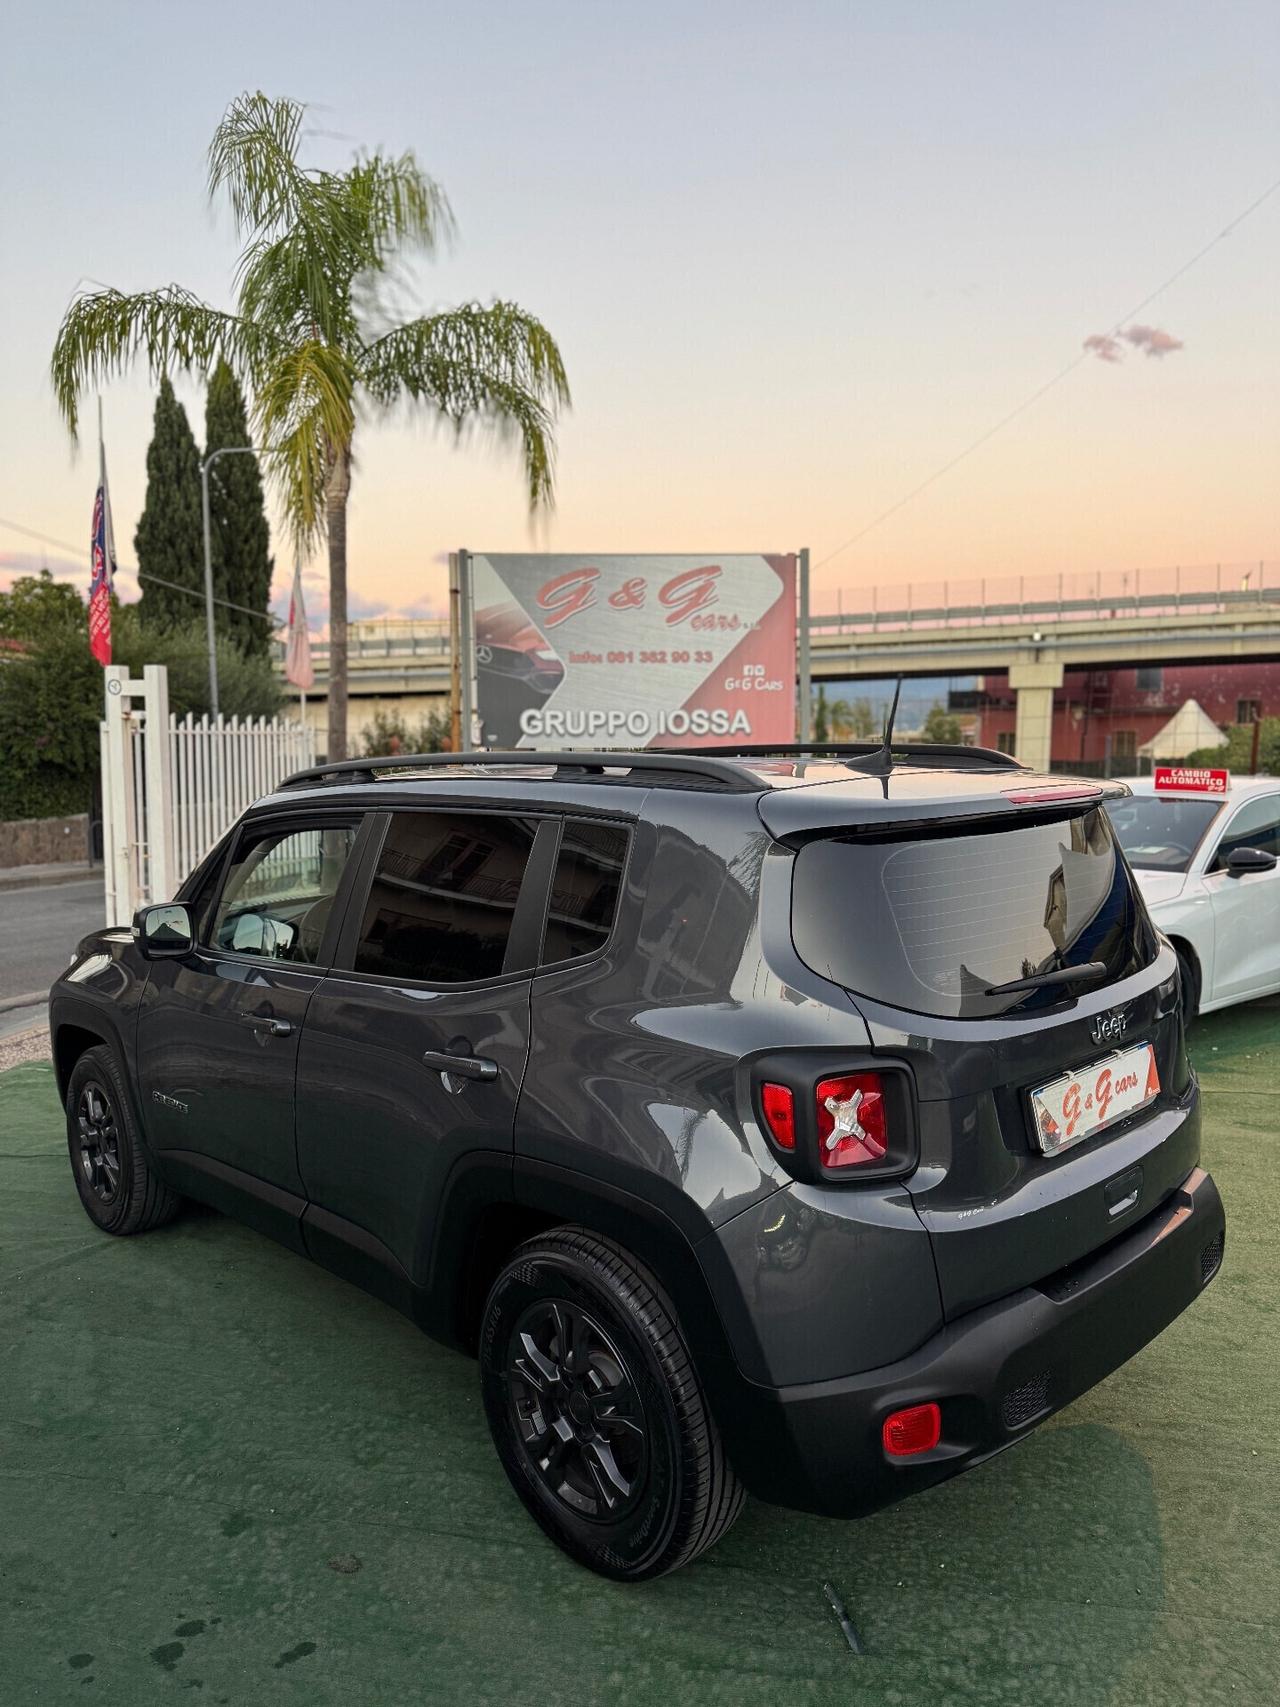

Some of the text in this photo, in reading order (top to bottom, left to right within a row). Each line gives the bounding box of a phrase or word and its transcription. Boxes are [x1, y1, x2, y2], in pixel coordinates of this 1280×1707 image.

[608, 577, 649, 611] &
[520, 709, 752, 736] GRUPPO IOSSA
[1158, 776, 1224, 786] AUTOMATICO
[1171, 769, 1211, 778] CAMBIO
[1091, 1013, 1127, 1042] Jeep
[1115, 1071, 1139, 1095] cars
